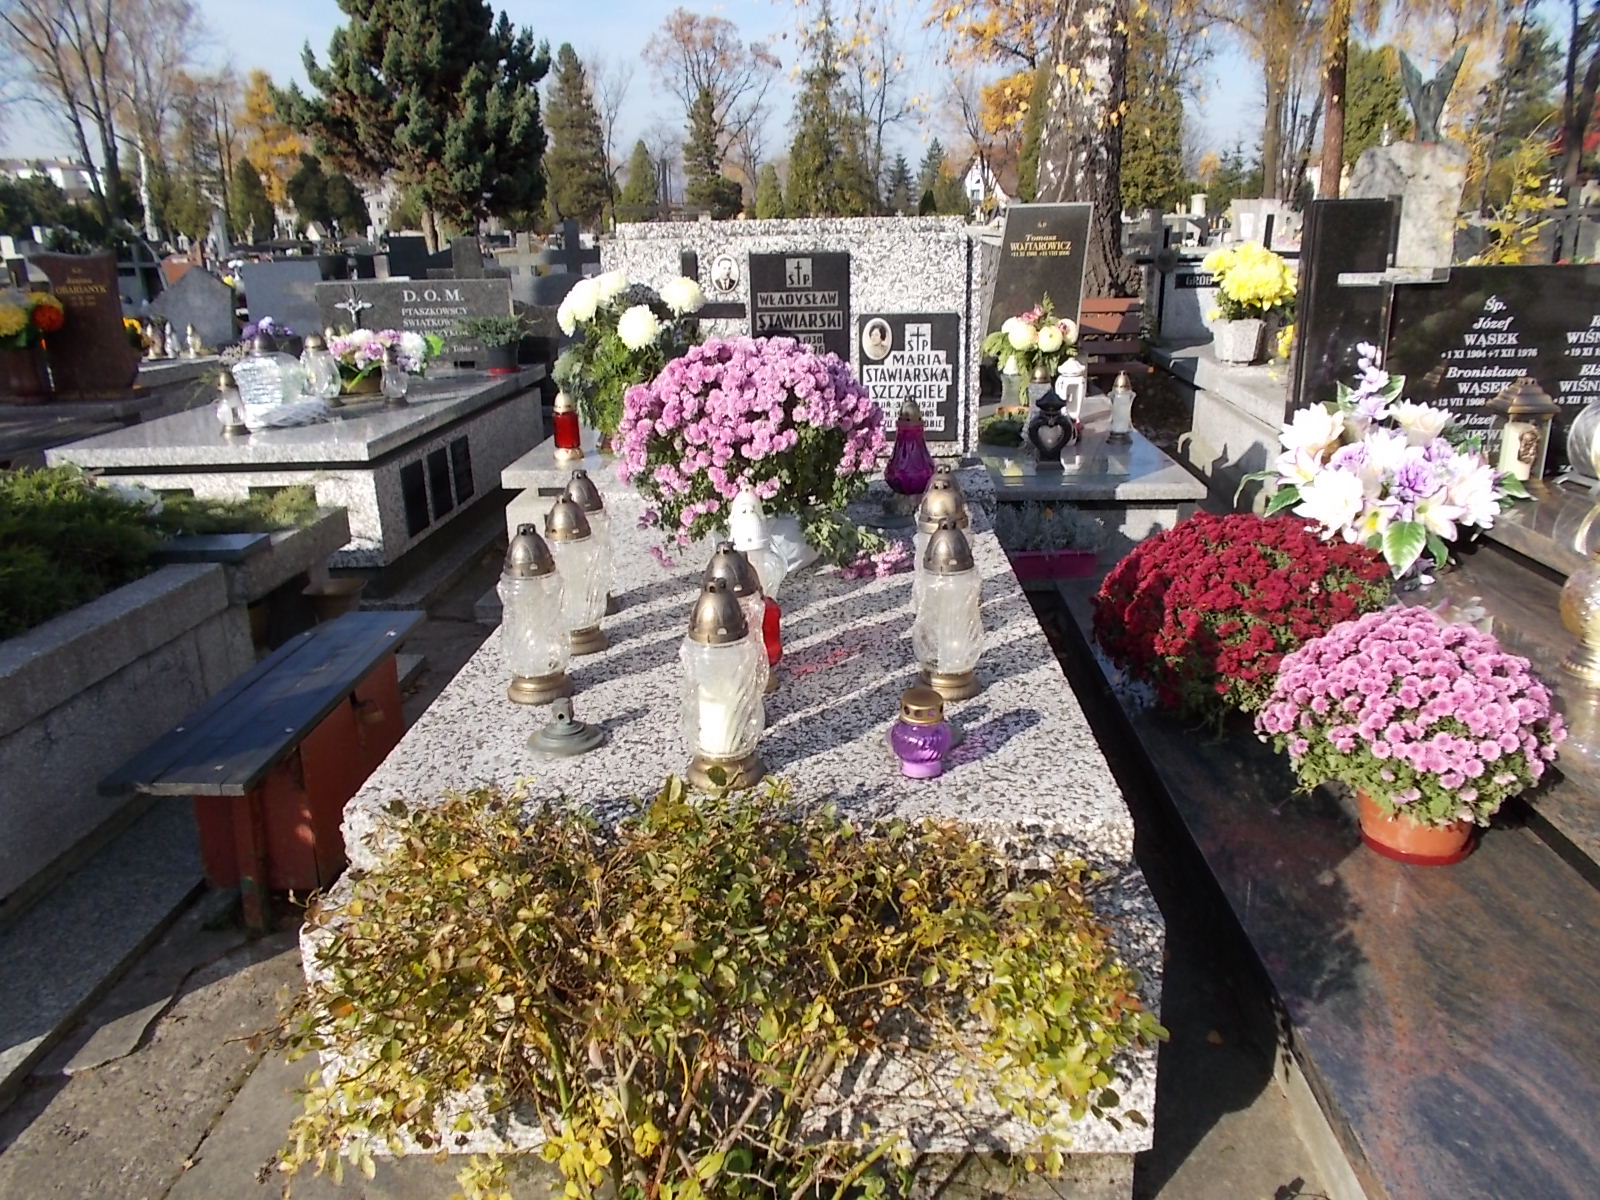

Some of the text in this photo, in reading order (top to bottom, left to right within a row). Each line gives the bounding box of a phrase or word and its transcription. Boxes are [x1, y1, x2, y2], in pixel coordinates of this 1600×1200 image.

[759, 293, 837, 306] WŁADYSŁAW
[758, 312, 843, 328] STAWIARSKI
[1472, 317, 1514, 331] Józef
[1464, 333, 1520, 348] WĄSEK
[893, 354, 942, 366] MARIA
[866, 368, 949, 382] STAWIARSKA
[1446, 365, 1528, 378] Bronisława
[872, 385, 945, 399] SZCZYGIEŁ
